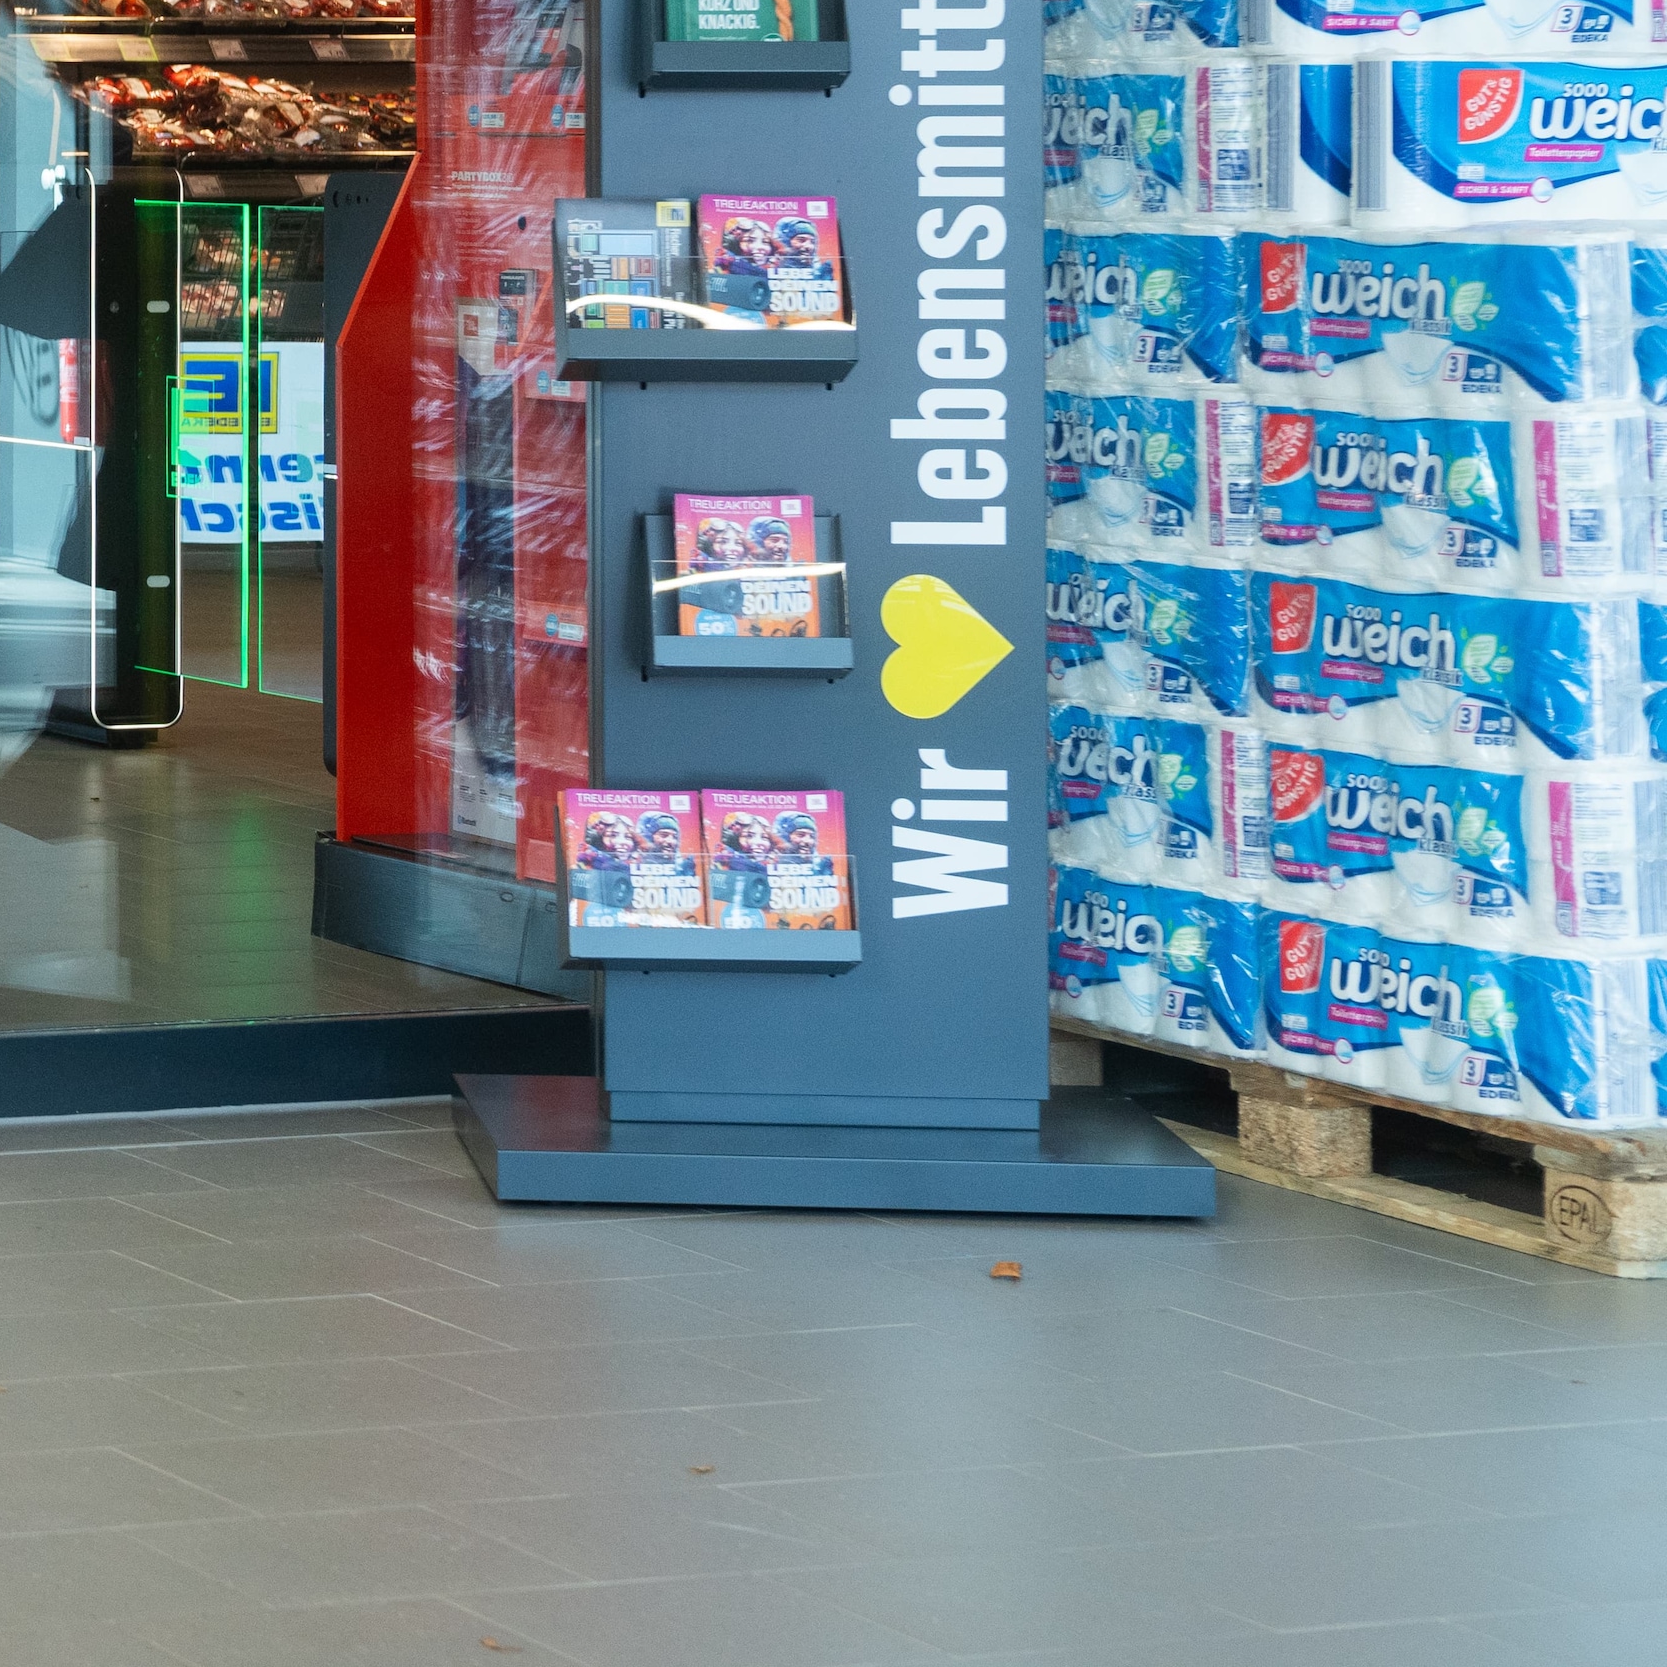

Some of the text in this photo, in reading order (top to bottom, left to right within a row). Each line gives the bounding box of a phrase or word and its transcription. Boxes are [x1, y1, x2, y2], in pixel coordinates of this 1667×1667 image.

[698, 13, 761, 30] KNACKIG.
[1326, 16, 1357, 28] SICHER
[1560, 7, 1573, 27] 3
[1571, 32, 1609, 44] EDEKA
[1463, 76, 1513, 131] GÜNSTIG
[1528, 146, 1600, 160] Toilettenpapier
[1457, 184, 1490, 194] SICHER
[713, 198, 799, 211] TREUEAKTION
[768, 267, 814, 280] LEBE
[1311, 262, 1446, 320] weich
[769, 291, 840, 313] SOUND
[1449, 355, 1459, 373] 3
[1461, 383, 1503, 394] EDEKA
[1313, 436, 1444, 496] weich
[688, 498, 772, 511] TREUEAKTION
[1445, 531, 1457, 549] 3
[741, 592, 813, 615] SOUND
[1322, 610, 1456, 670] weich
[1460, 707, 1472, 725] 3
[576, 792, 661, 805] TREUEAKTION
[712, 792, 798, 805] TREUEAKTION
[1326, 781, 1454, 841] weich
[892, 748, 1009, 920] Wir
[629, 863, 676, 876] LEBE
[767, 863, 813, 876] LEBE
[631, 875, 700, 887] DEINEN
[768, 875, 839, 887] DEINEN
[632, 887, 702, 909] SOUND
[769, 887, 841, 910] SOUND
[1469, 906, 1516, 918] EDEKA
[1329, 957, 1463, 1023] weich
[1466, 1059, 1477, 1078] 3
